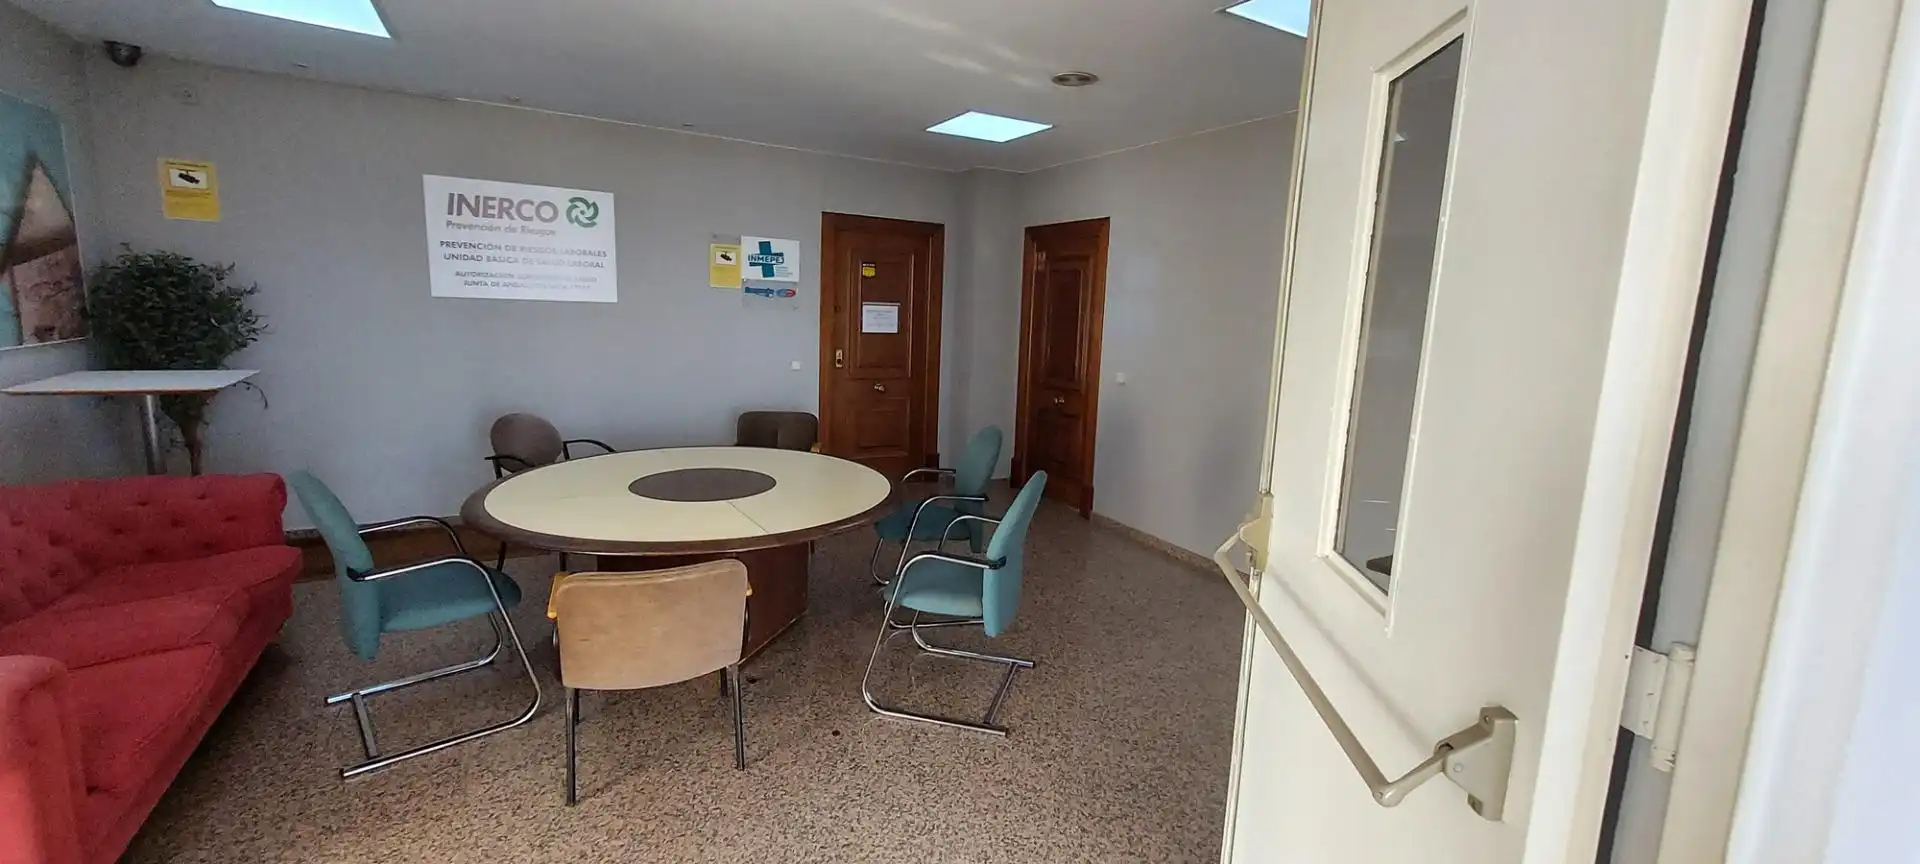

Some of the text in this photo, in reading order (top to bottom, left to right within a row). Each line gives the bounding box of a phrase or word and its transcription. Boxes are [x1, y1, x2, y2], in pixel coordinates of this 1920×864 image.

[447, 193, 559, 223] INERCO
[504, 224, 517, 233] de
[443, 252, 484, 262] UNIDAD
